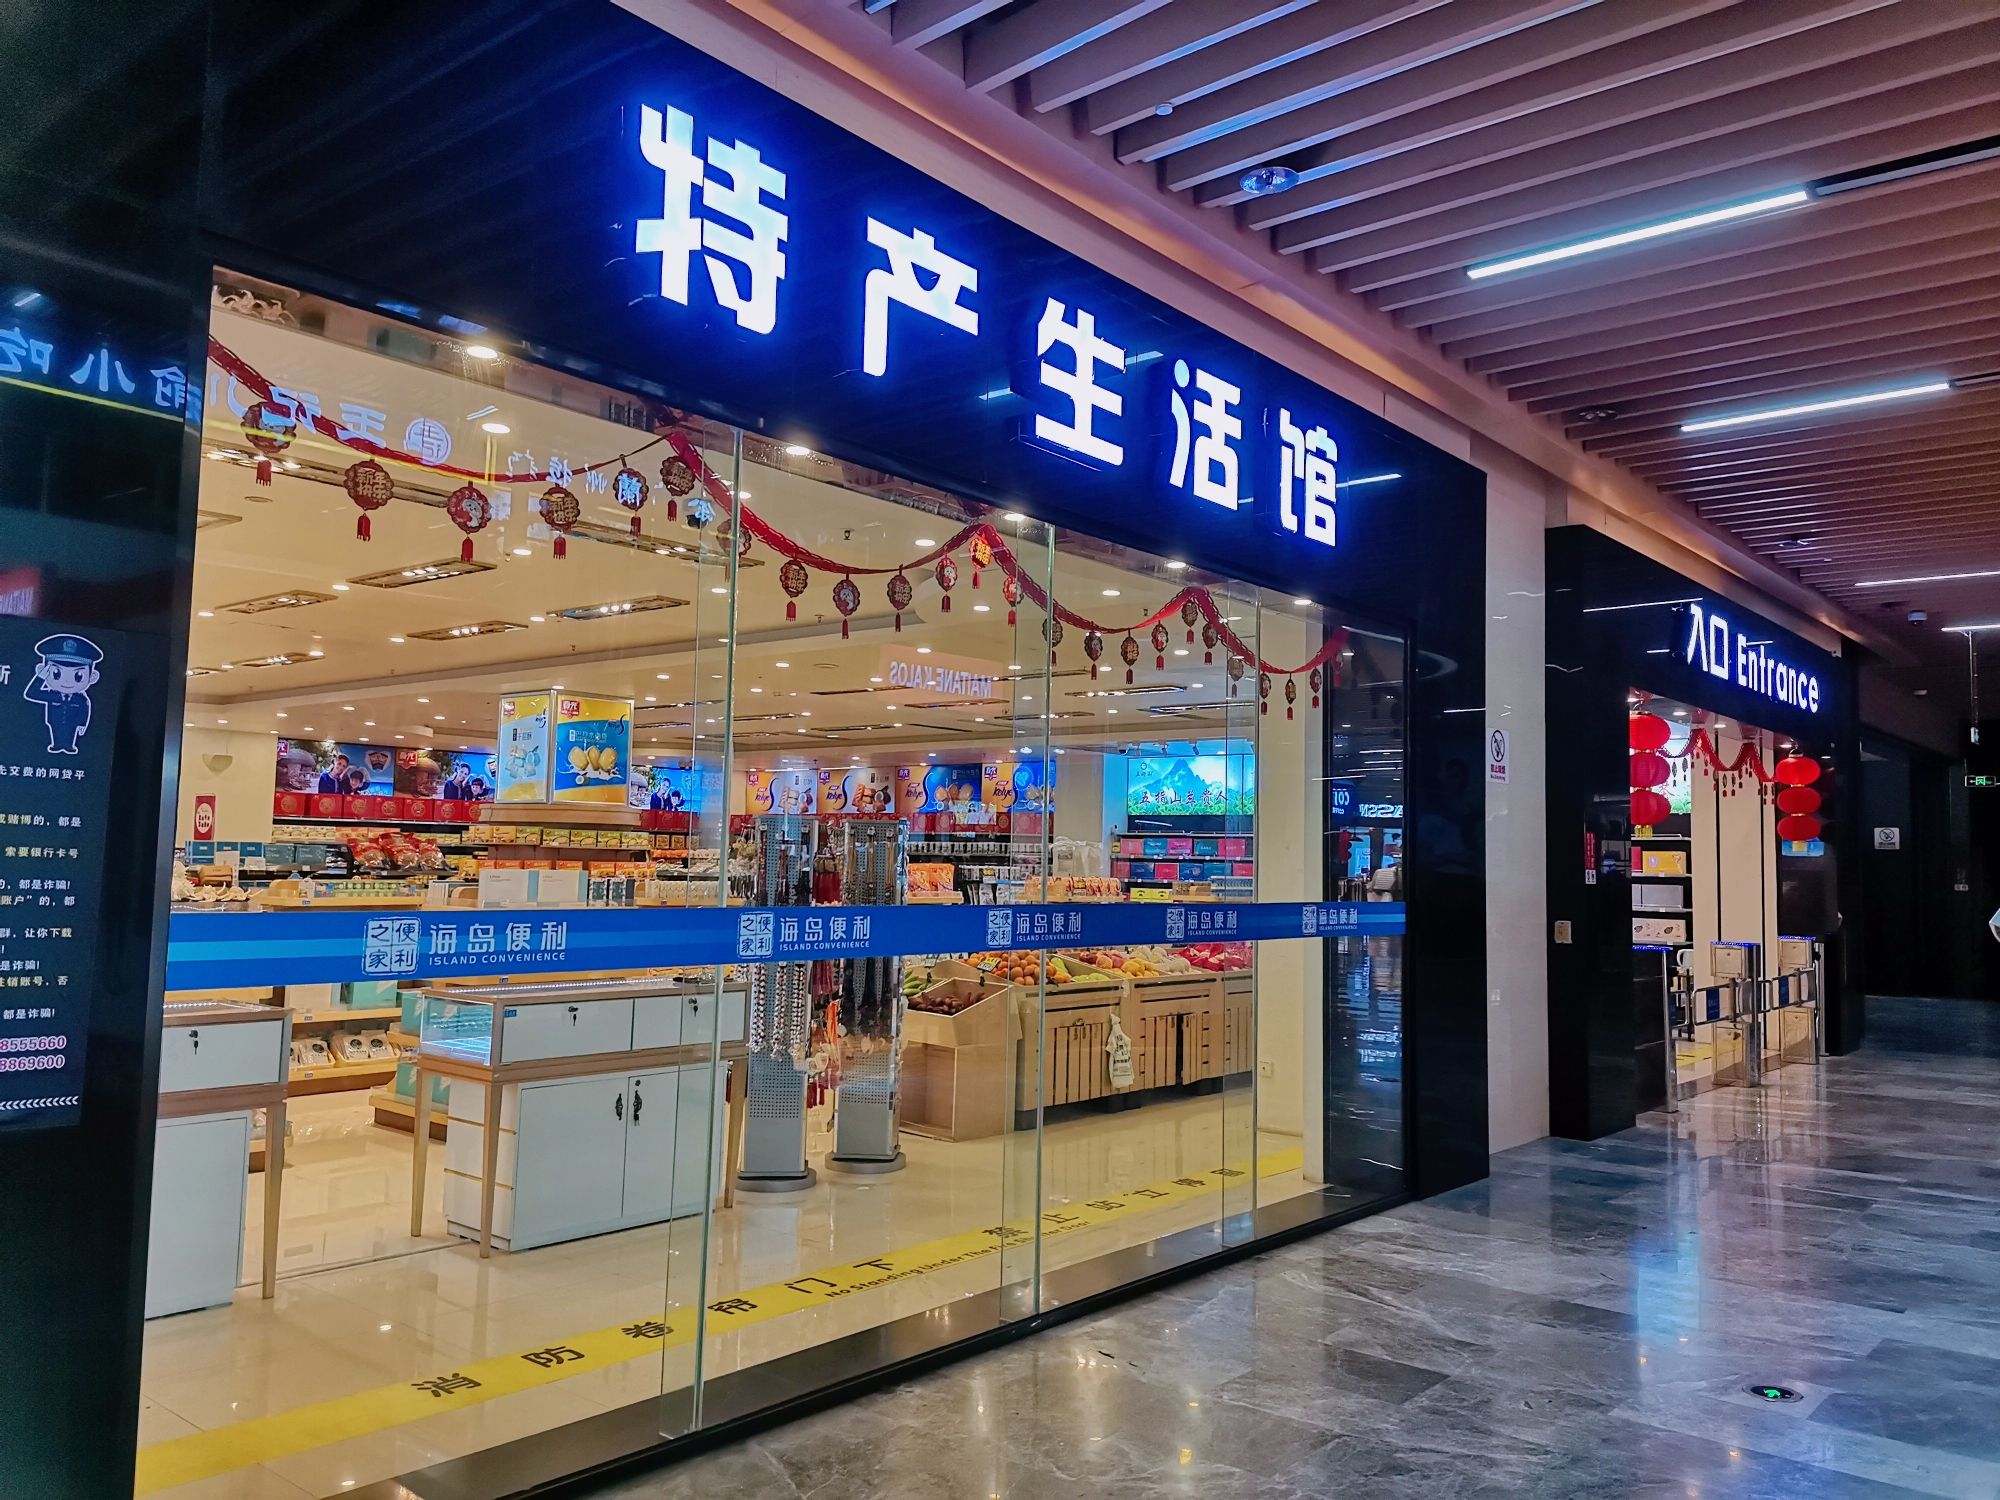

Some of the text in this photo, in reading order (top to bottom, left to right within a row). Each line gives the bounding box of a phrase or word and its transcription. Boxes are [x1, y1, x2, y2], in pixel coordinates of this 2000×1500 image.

[634, 104, 1338, 547] 特产生活馆
[1687, 603, 1729, 680] 入口
[1738, 633, 1819, 713] Entrance
[780, 915, 871, 942] 海岛便利
[1016, 912, 1081, 934] 海岛便利
[1187, 910, 1237, 929] 海岛便利
[429, 921, 567, 955] 海岛便利
[780, 941, 870, 951] ISLAND CONVENIENCE
[429, 952, 565, 966] ISLAND CONVENIENCE
[850, 1268, 923, 1291] Standing
